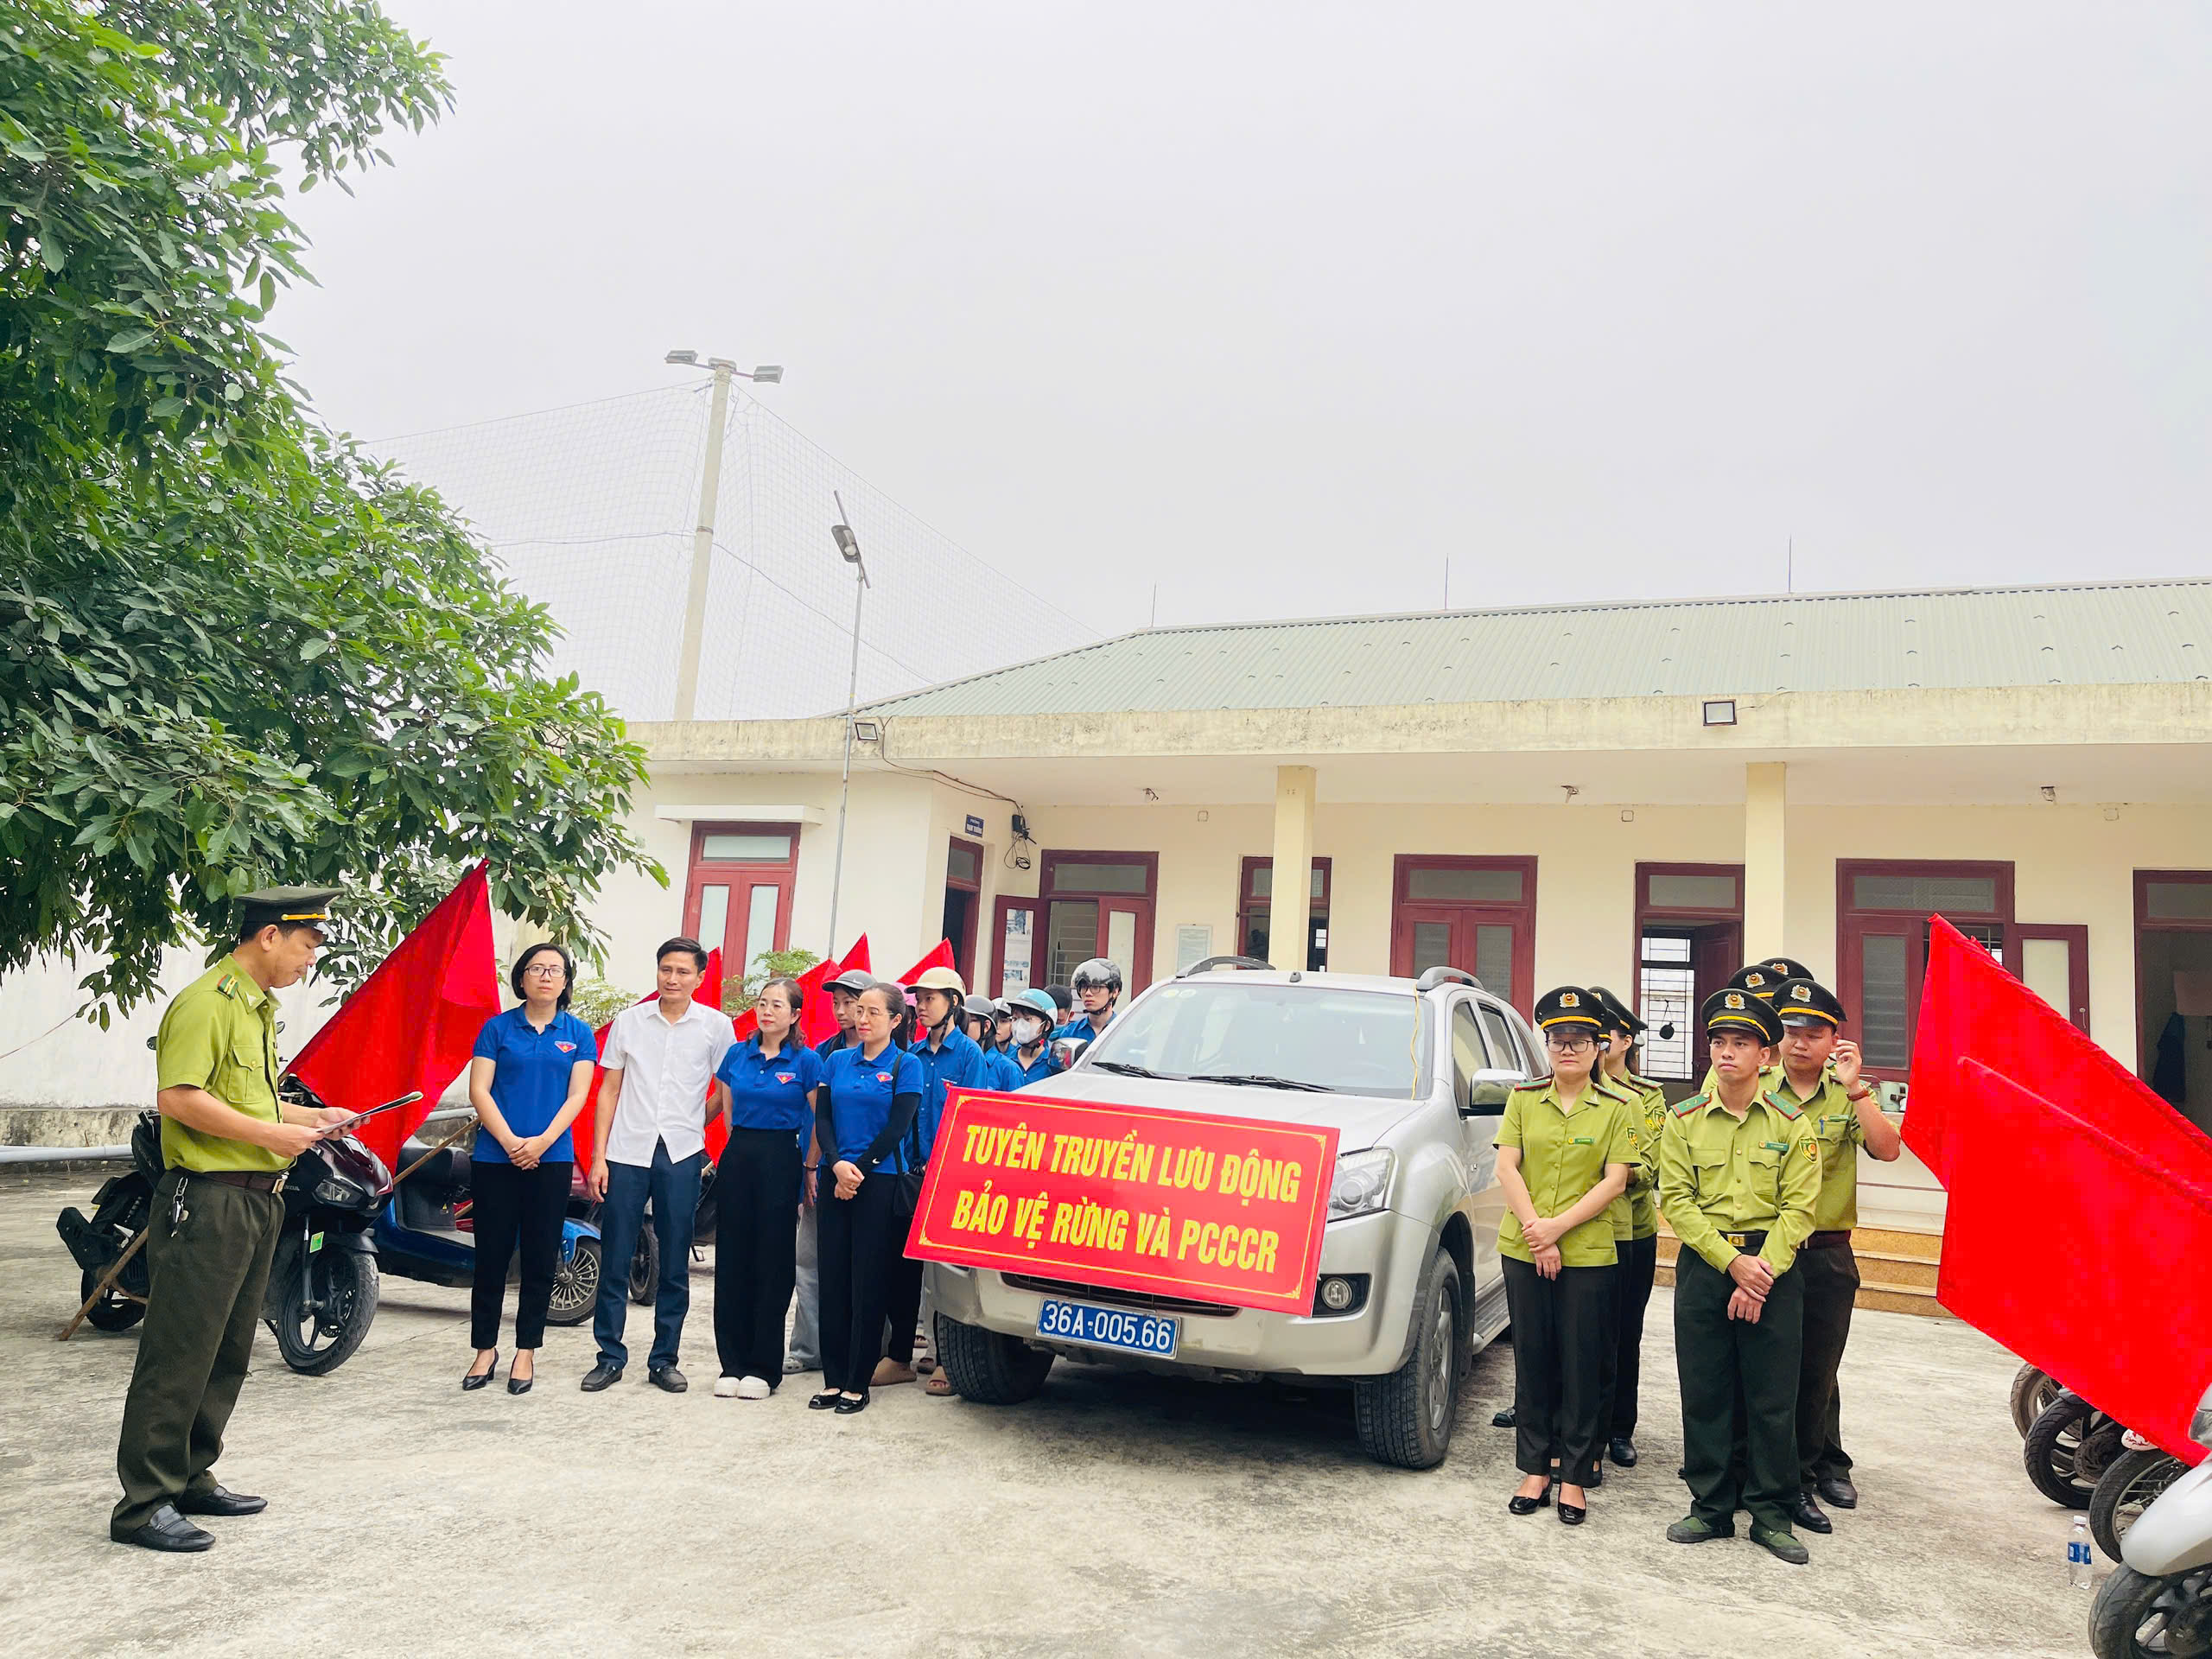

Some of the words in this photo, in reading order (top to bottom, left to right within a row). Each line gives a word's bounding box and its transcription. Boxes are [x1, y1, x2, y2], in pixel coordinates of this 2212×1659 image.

[963, 1122, 1047, 1170] TUYÊN
[1050, 1129, 1155, 1183] TRUYỀN
[1157, 1147, 1215, 1192] LƯU
[1218, 1149, 1302, 1206] ĐỘNG
[951, 1180, 1009, 1234] BẢO
[1014, 1192, 1049, 1249] VỆ
[1051, 1196, 1130, 1251] RỪNG
[1135, 1207, 1171, 1257] VÀ
[1178, 1219, 1280, 1273] PCCCR
